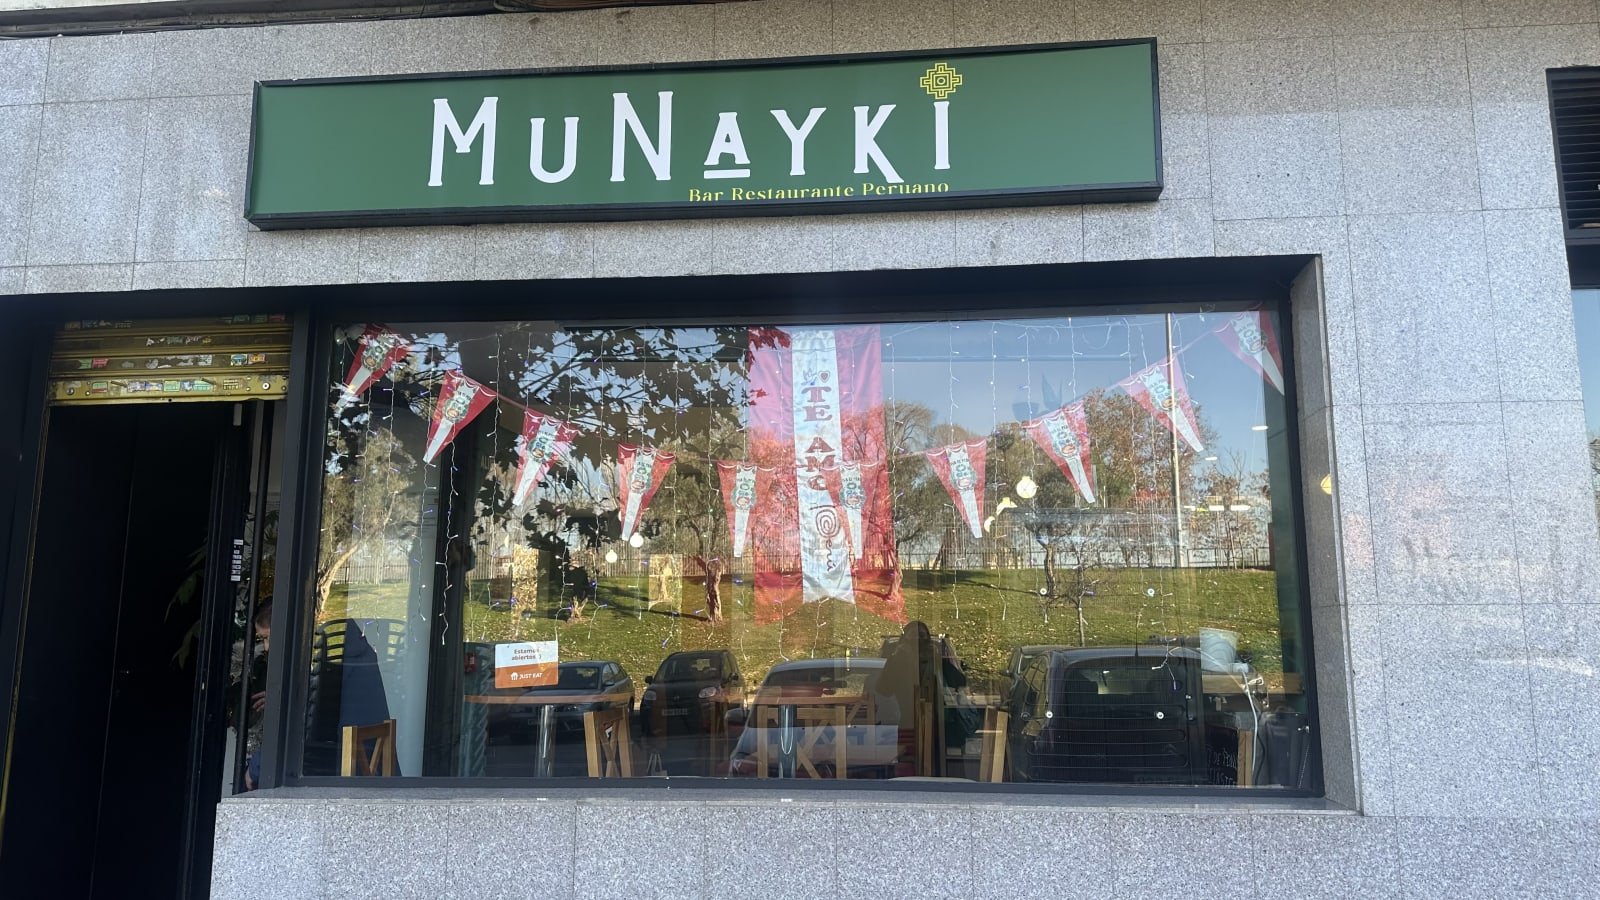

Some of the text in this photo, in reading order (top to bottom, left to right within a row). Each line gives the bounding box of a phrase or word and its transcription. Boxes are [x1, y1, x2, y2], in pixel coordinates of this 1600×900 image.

[688, 182, 950, 202] Bar Restaurante Peruano
[801, 385, 833, 422] TE
